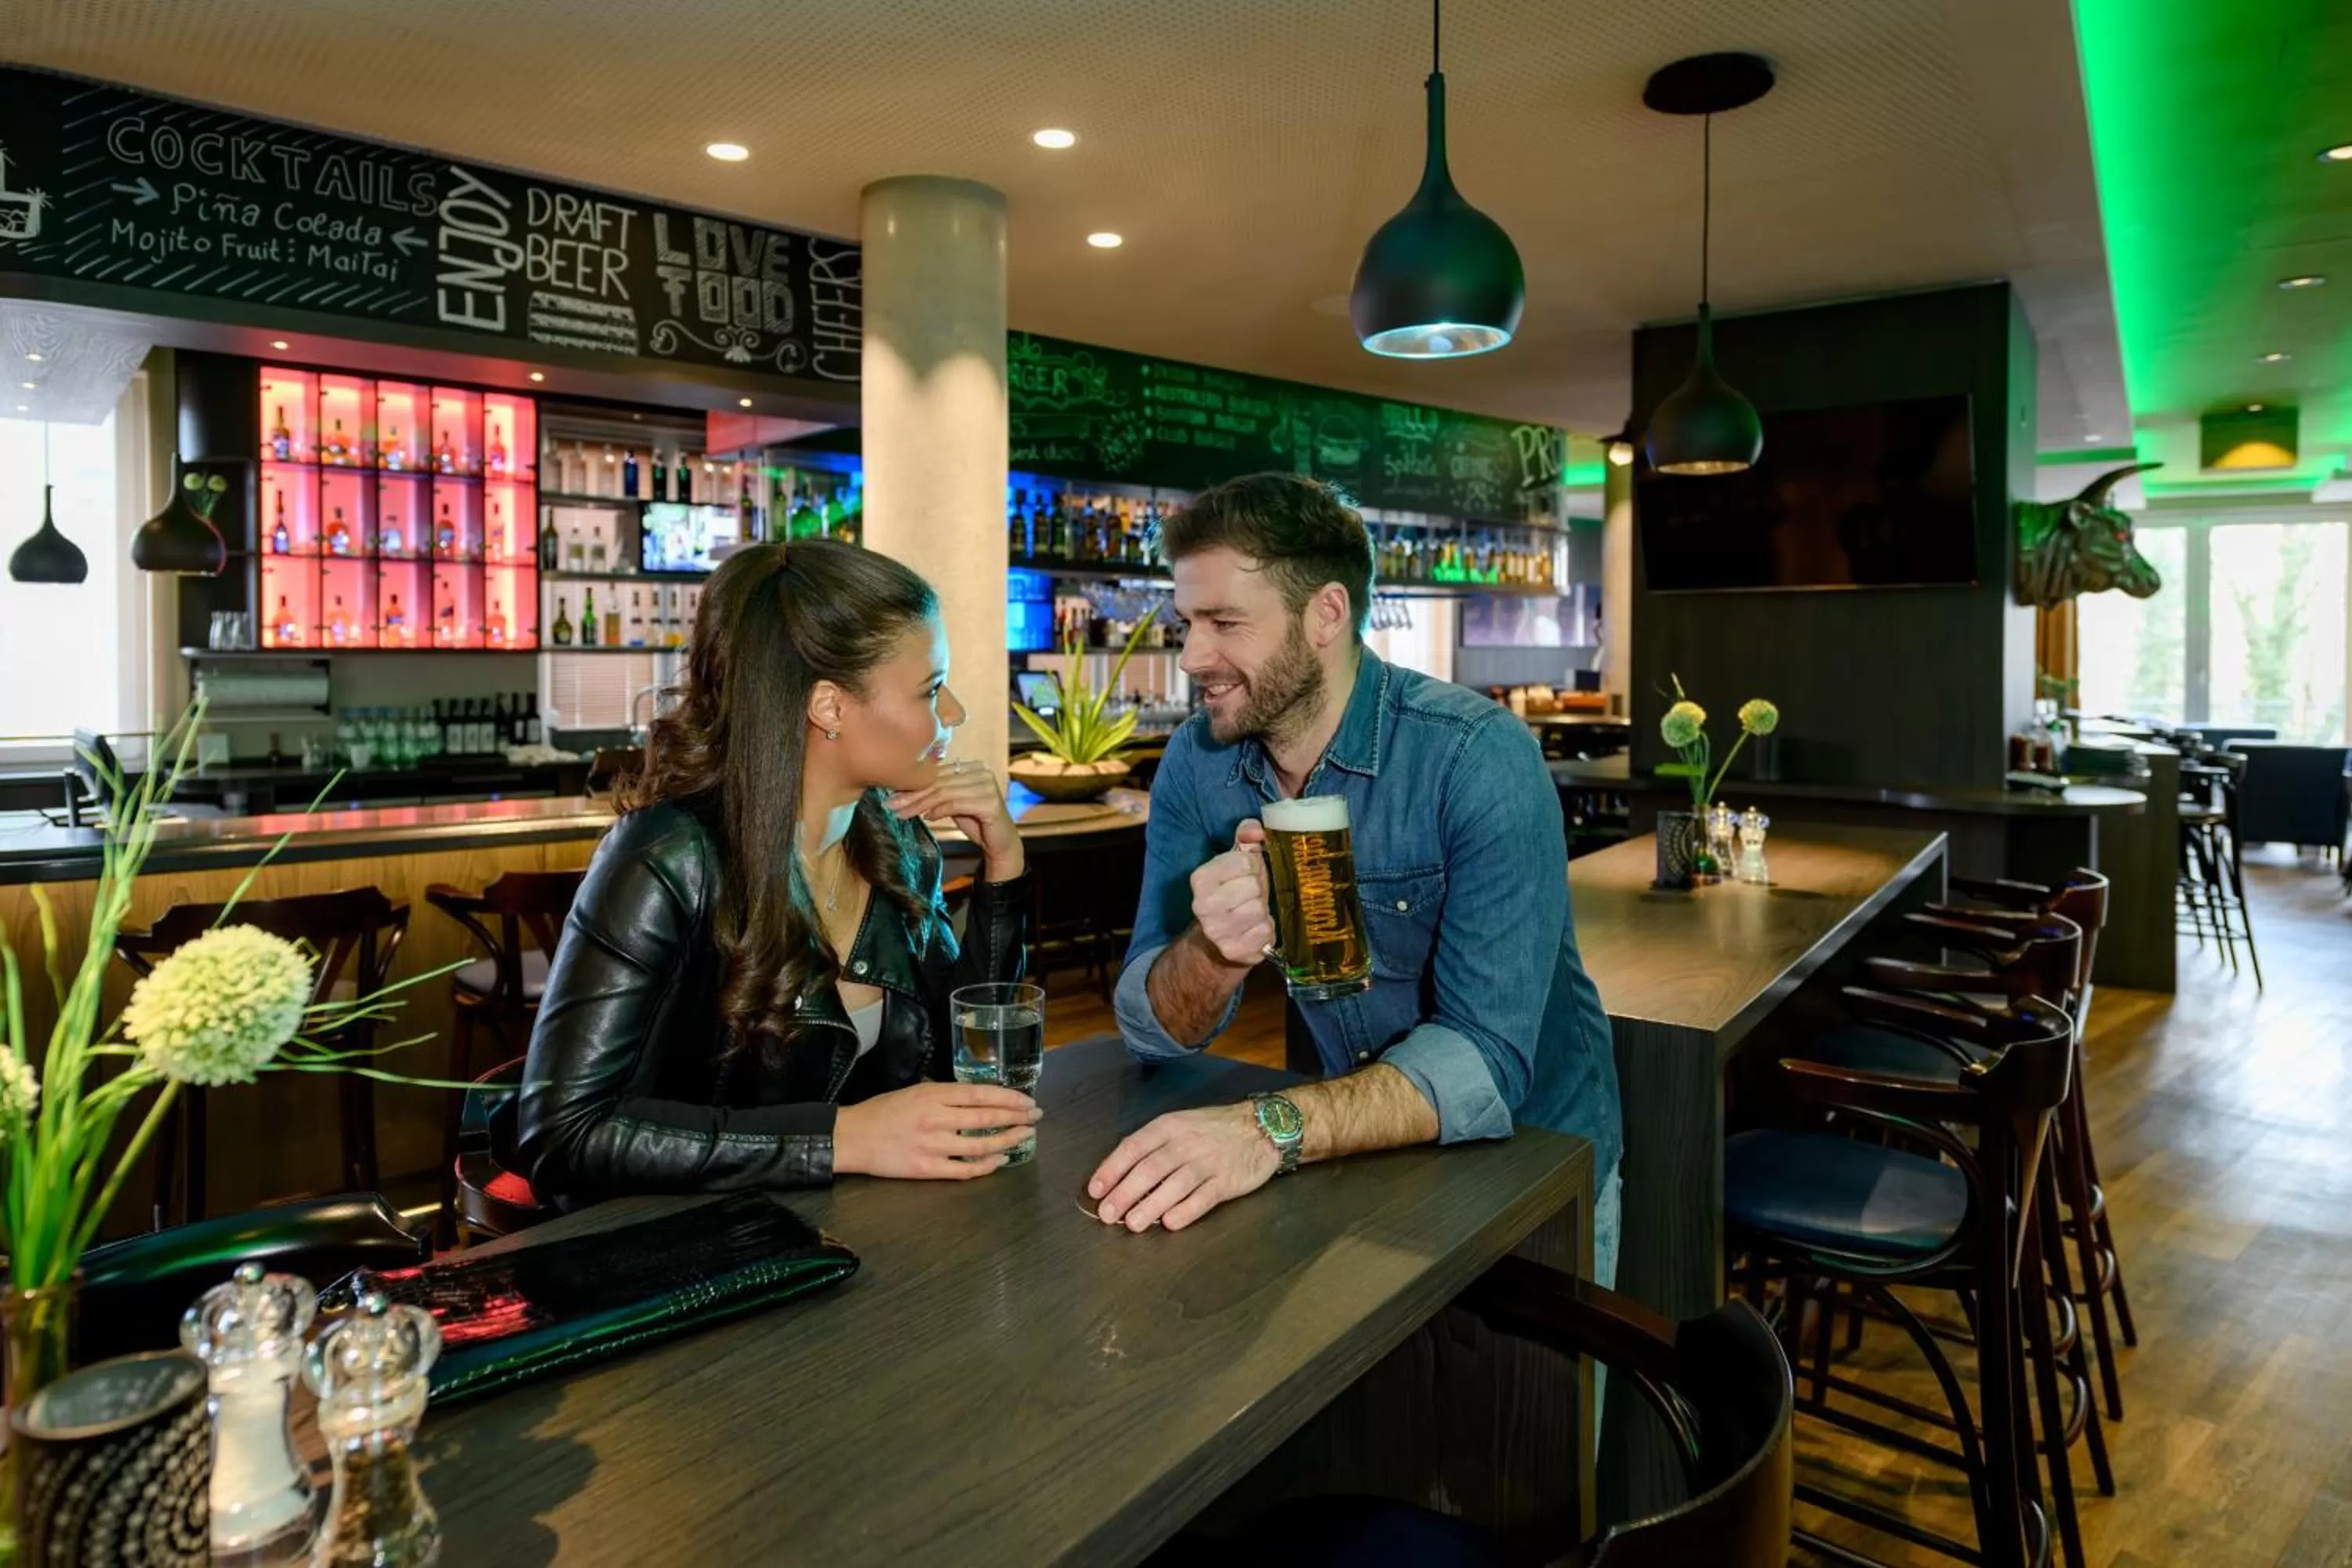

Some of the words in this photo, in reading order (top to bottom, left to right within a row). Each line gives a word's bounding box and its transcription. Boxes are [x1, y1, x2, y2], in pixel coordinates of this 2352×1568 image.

[107, 116, 438, 216] COCKTAILS
[111, 218, 210, 263] Mojito
[170, 182, 261, 227] Piña
[274, 201, 383, 246] Colada
[527, 187, 638, 250] DRAFT
[436, 165, 525, 332] ENJOY
[527, 234, 630, 300] BEER
[653, 212, 791, 284] LOVE
